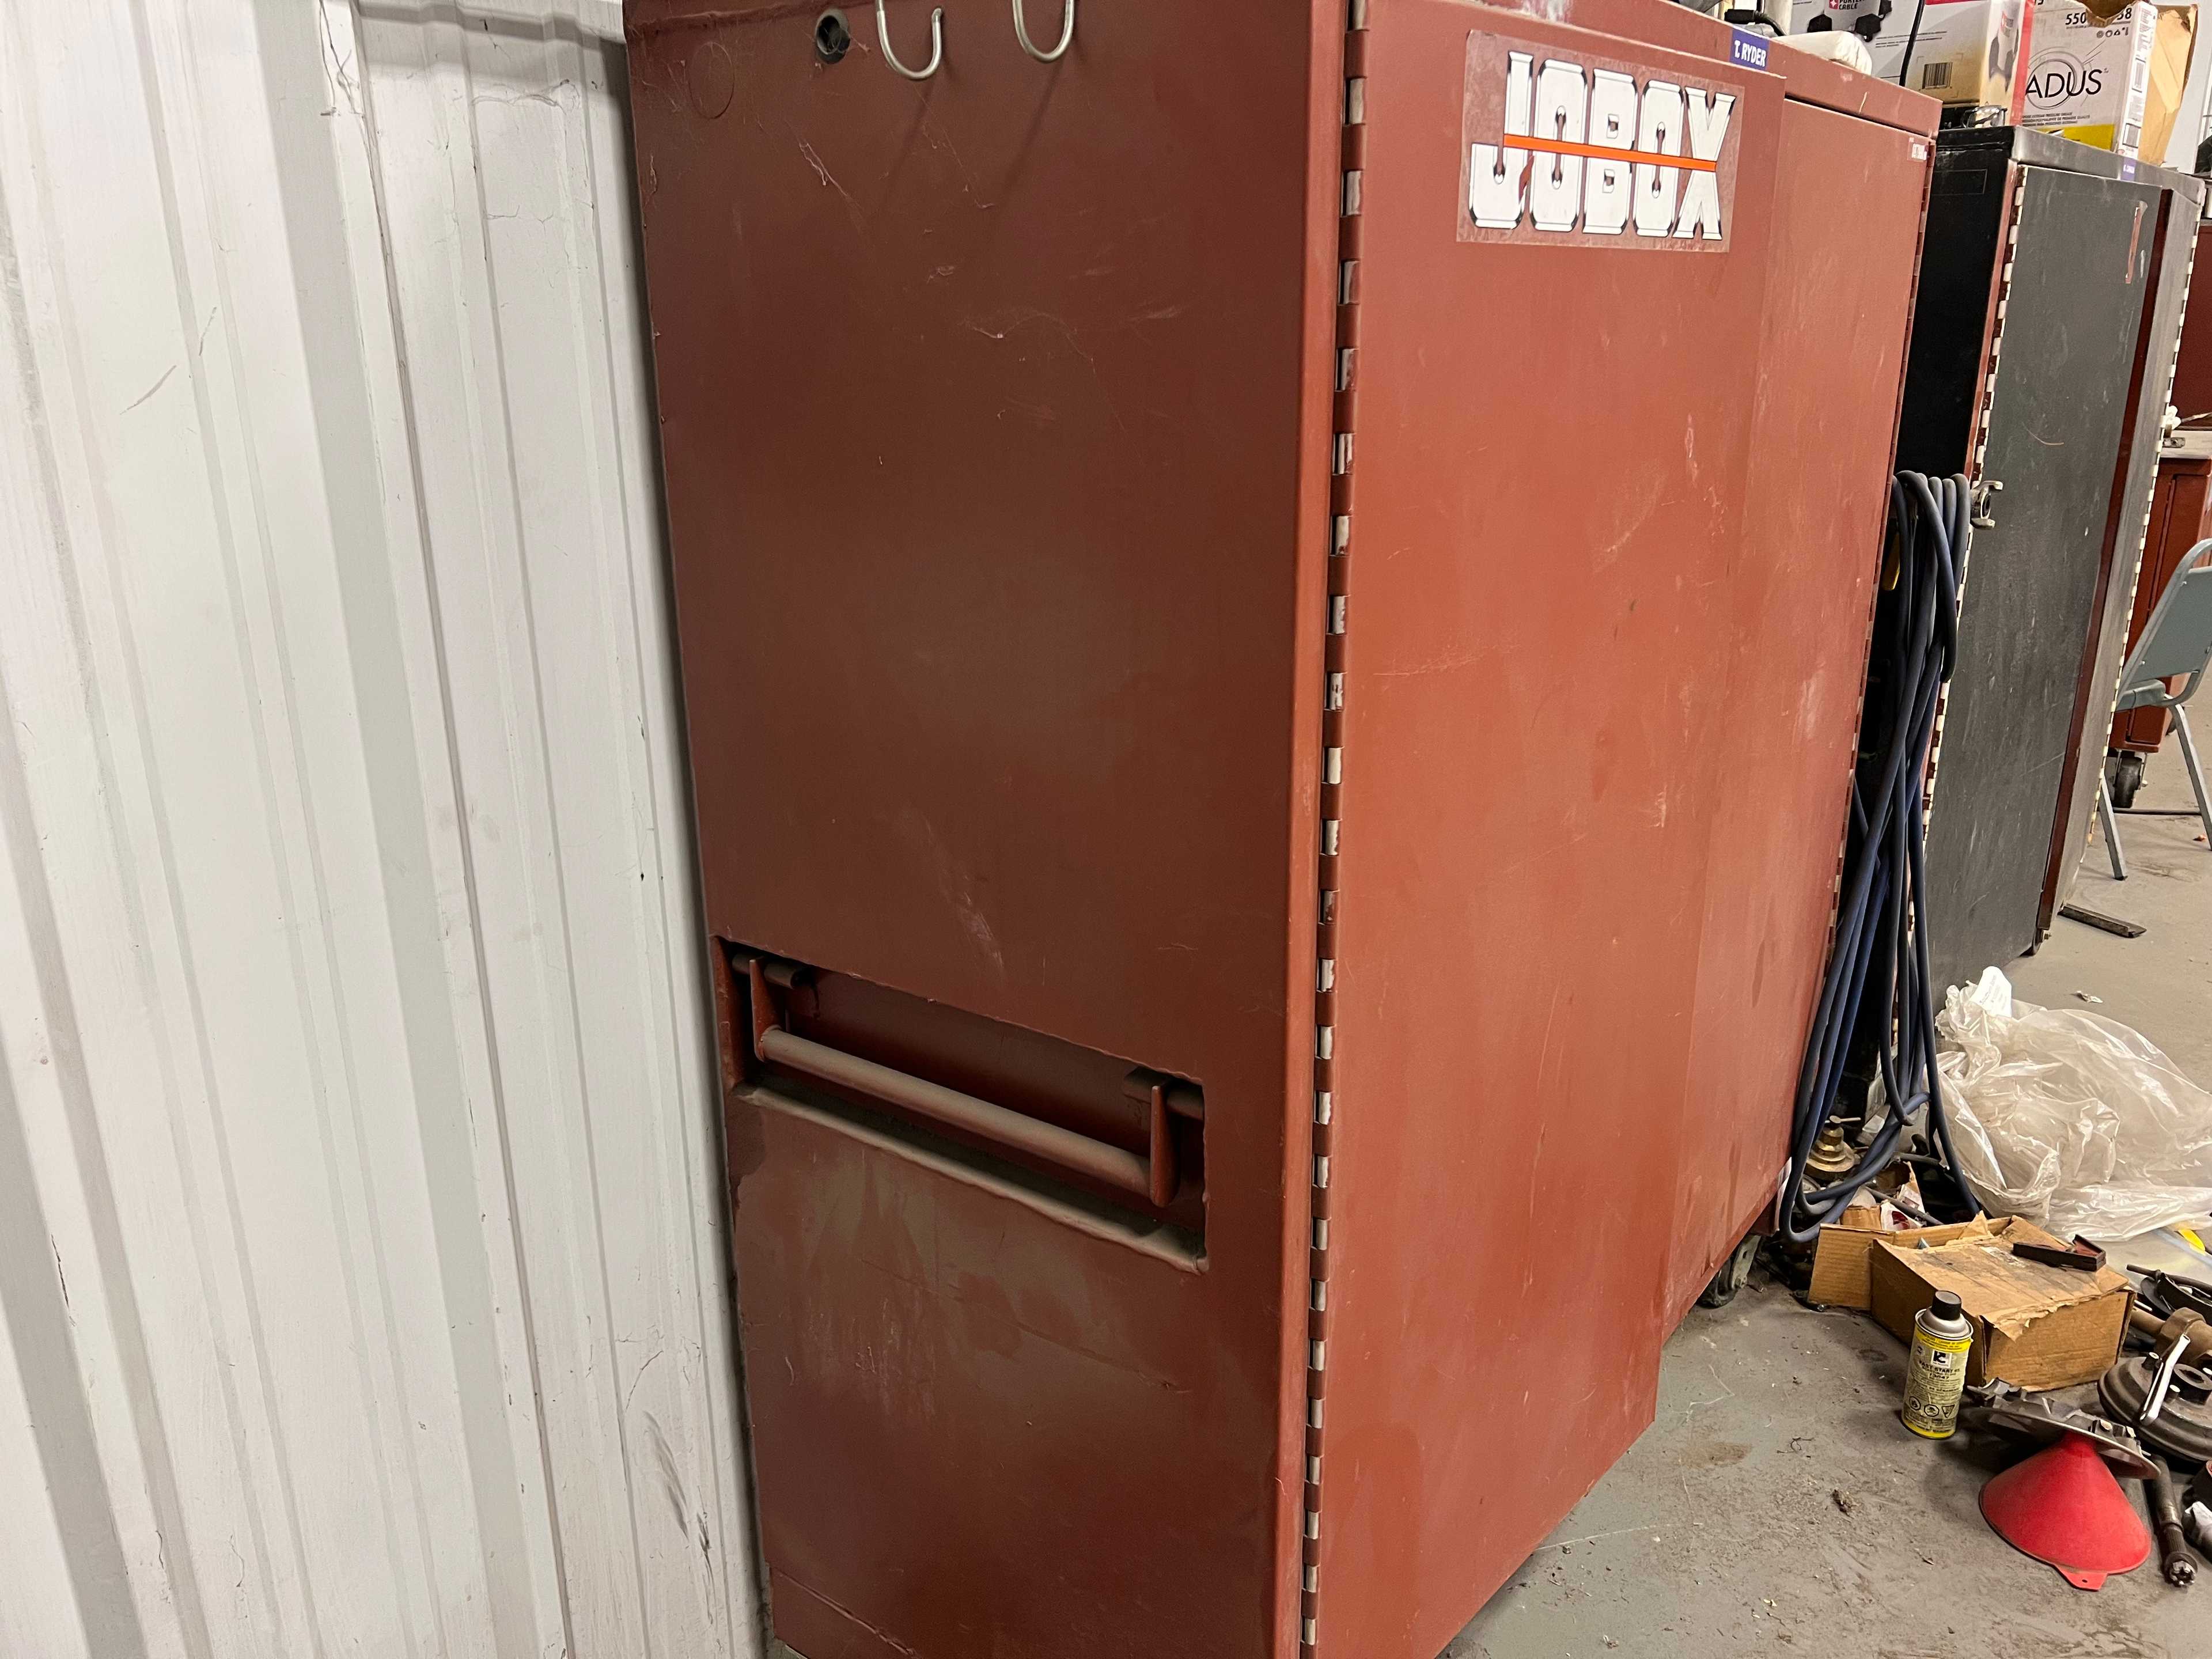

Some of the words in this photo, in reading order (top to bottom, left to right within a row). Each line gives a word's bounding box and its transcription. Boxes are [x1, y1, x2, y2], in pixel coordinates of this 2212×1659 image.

[1741, 43, 1766, 67] RYDER
[2025, 69, 2103, 99] ADUS
[1469, 51, 1736, 240] JOBOX
